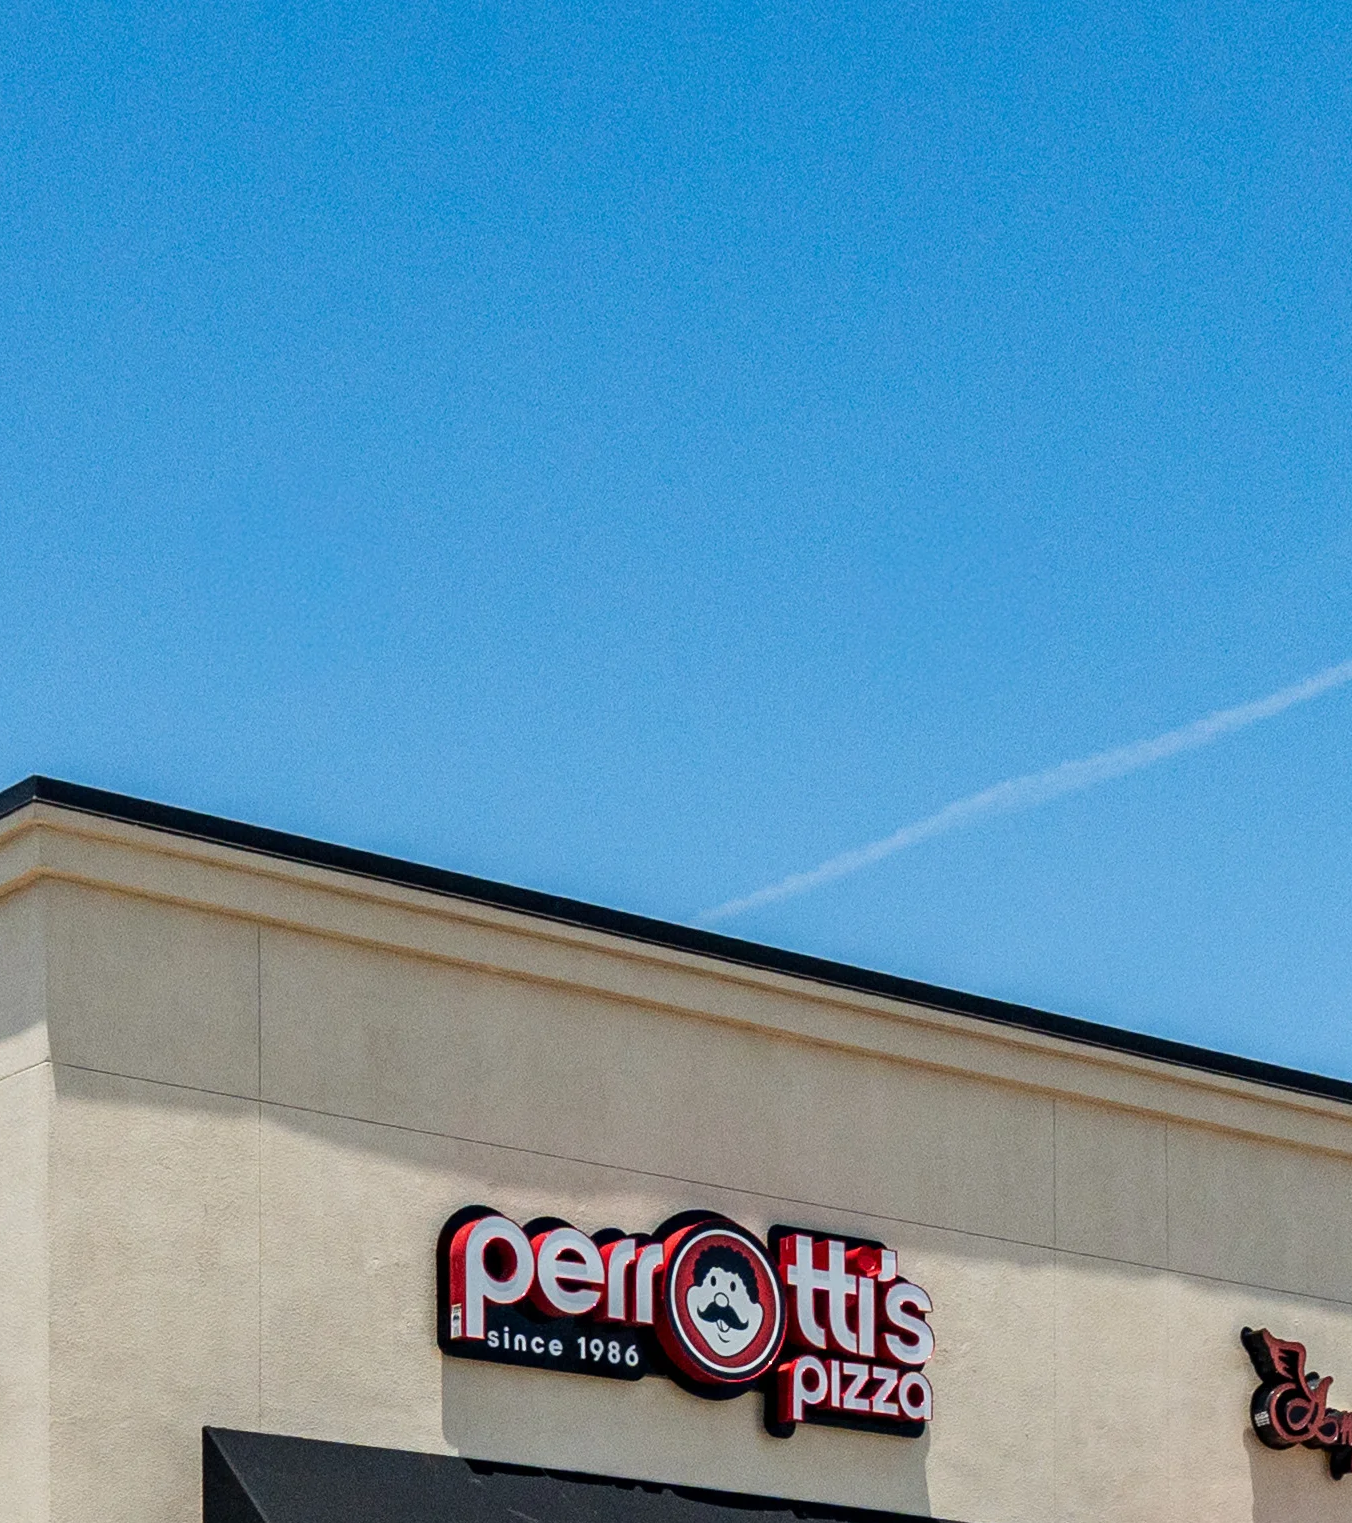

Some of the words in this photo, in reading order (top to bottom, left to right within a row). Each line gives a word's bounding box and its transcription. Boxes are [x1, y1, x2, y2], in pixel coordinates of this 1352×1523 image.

[487, 1326, 564, 1357] since
[577, 1335, 640, 1367] 1986
[793, 1356, 933, 1422] pizza
